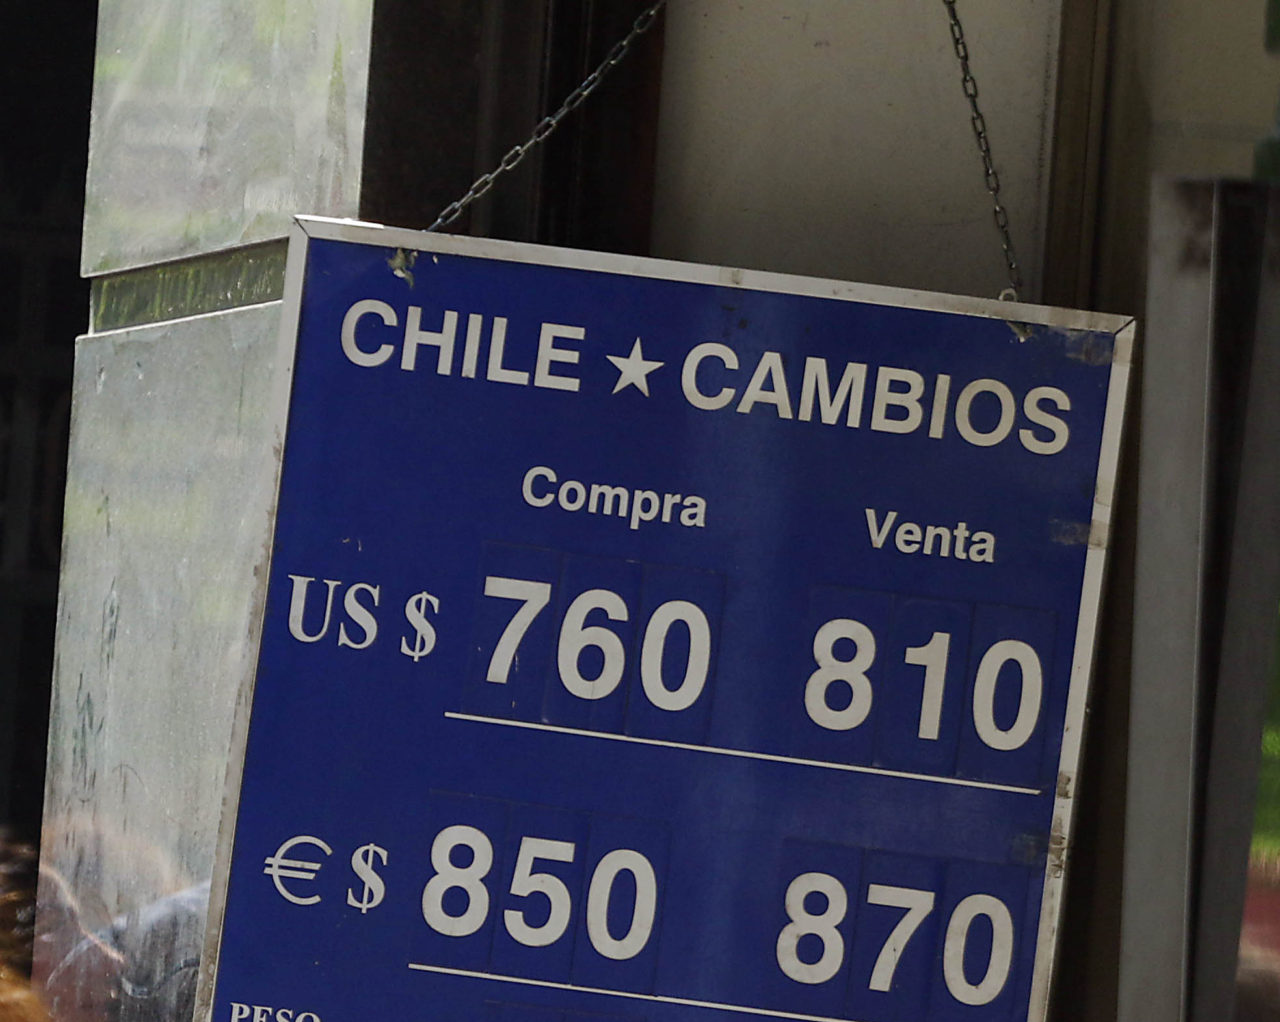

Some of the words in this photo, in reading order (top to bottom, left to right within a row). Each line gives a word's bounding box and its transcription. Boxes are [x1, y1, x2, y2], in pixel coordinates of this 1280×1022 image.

[342, 300, 585, 391] CHILE
[682, 343, 1070, 454] CAMBIOS
[523, 467, 705, 529] Compra
[866, 509, 994, 562] Venta
[289, 575, 379, 648] US
[401, 592, 438, 661] $
[484, 577, 710, 711] 760
[805, 619, 1042, 750] 810
[264, 836, 332, 904] €
[348, 844, 387, 913] $
[423, 826, 656, 959] 850
[777, 873, 1013, 1005] 870
